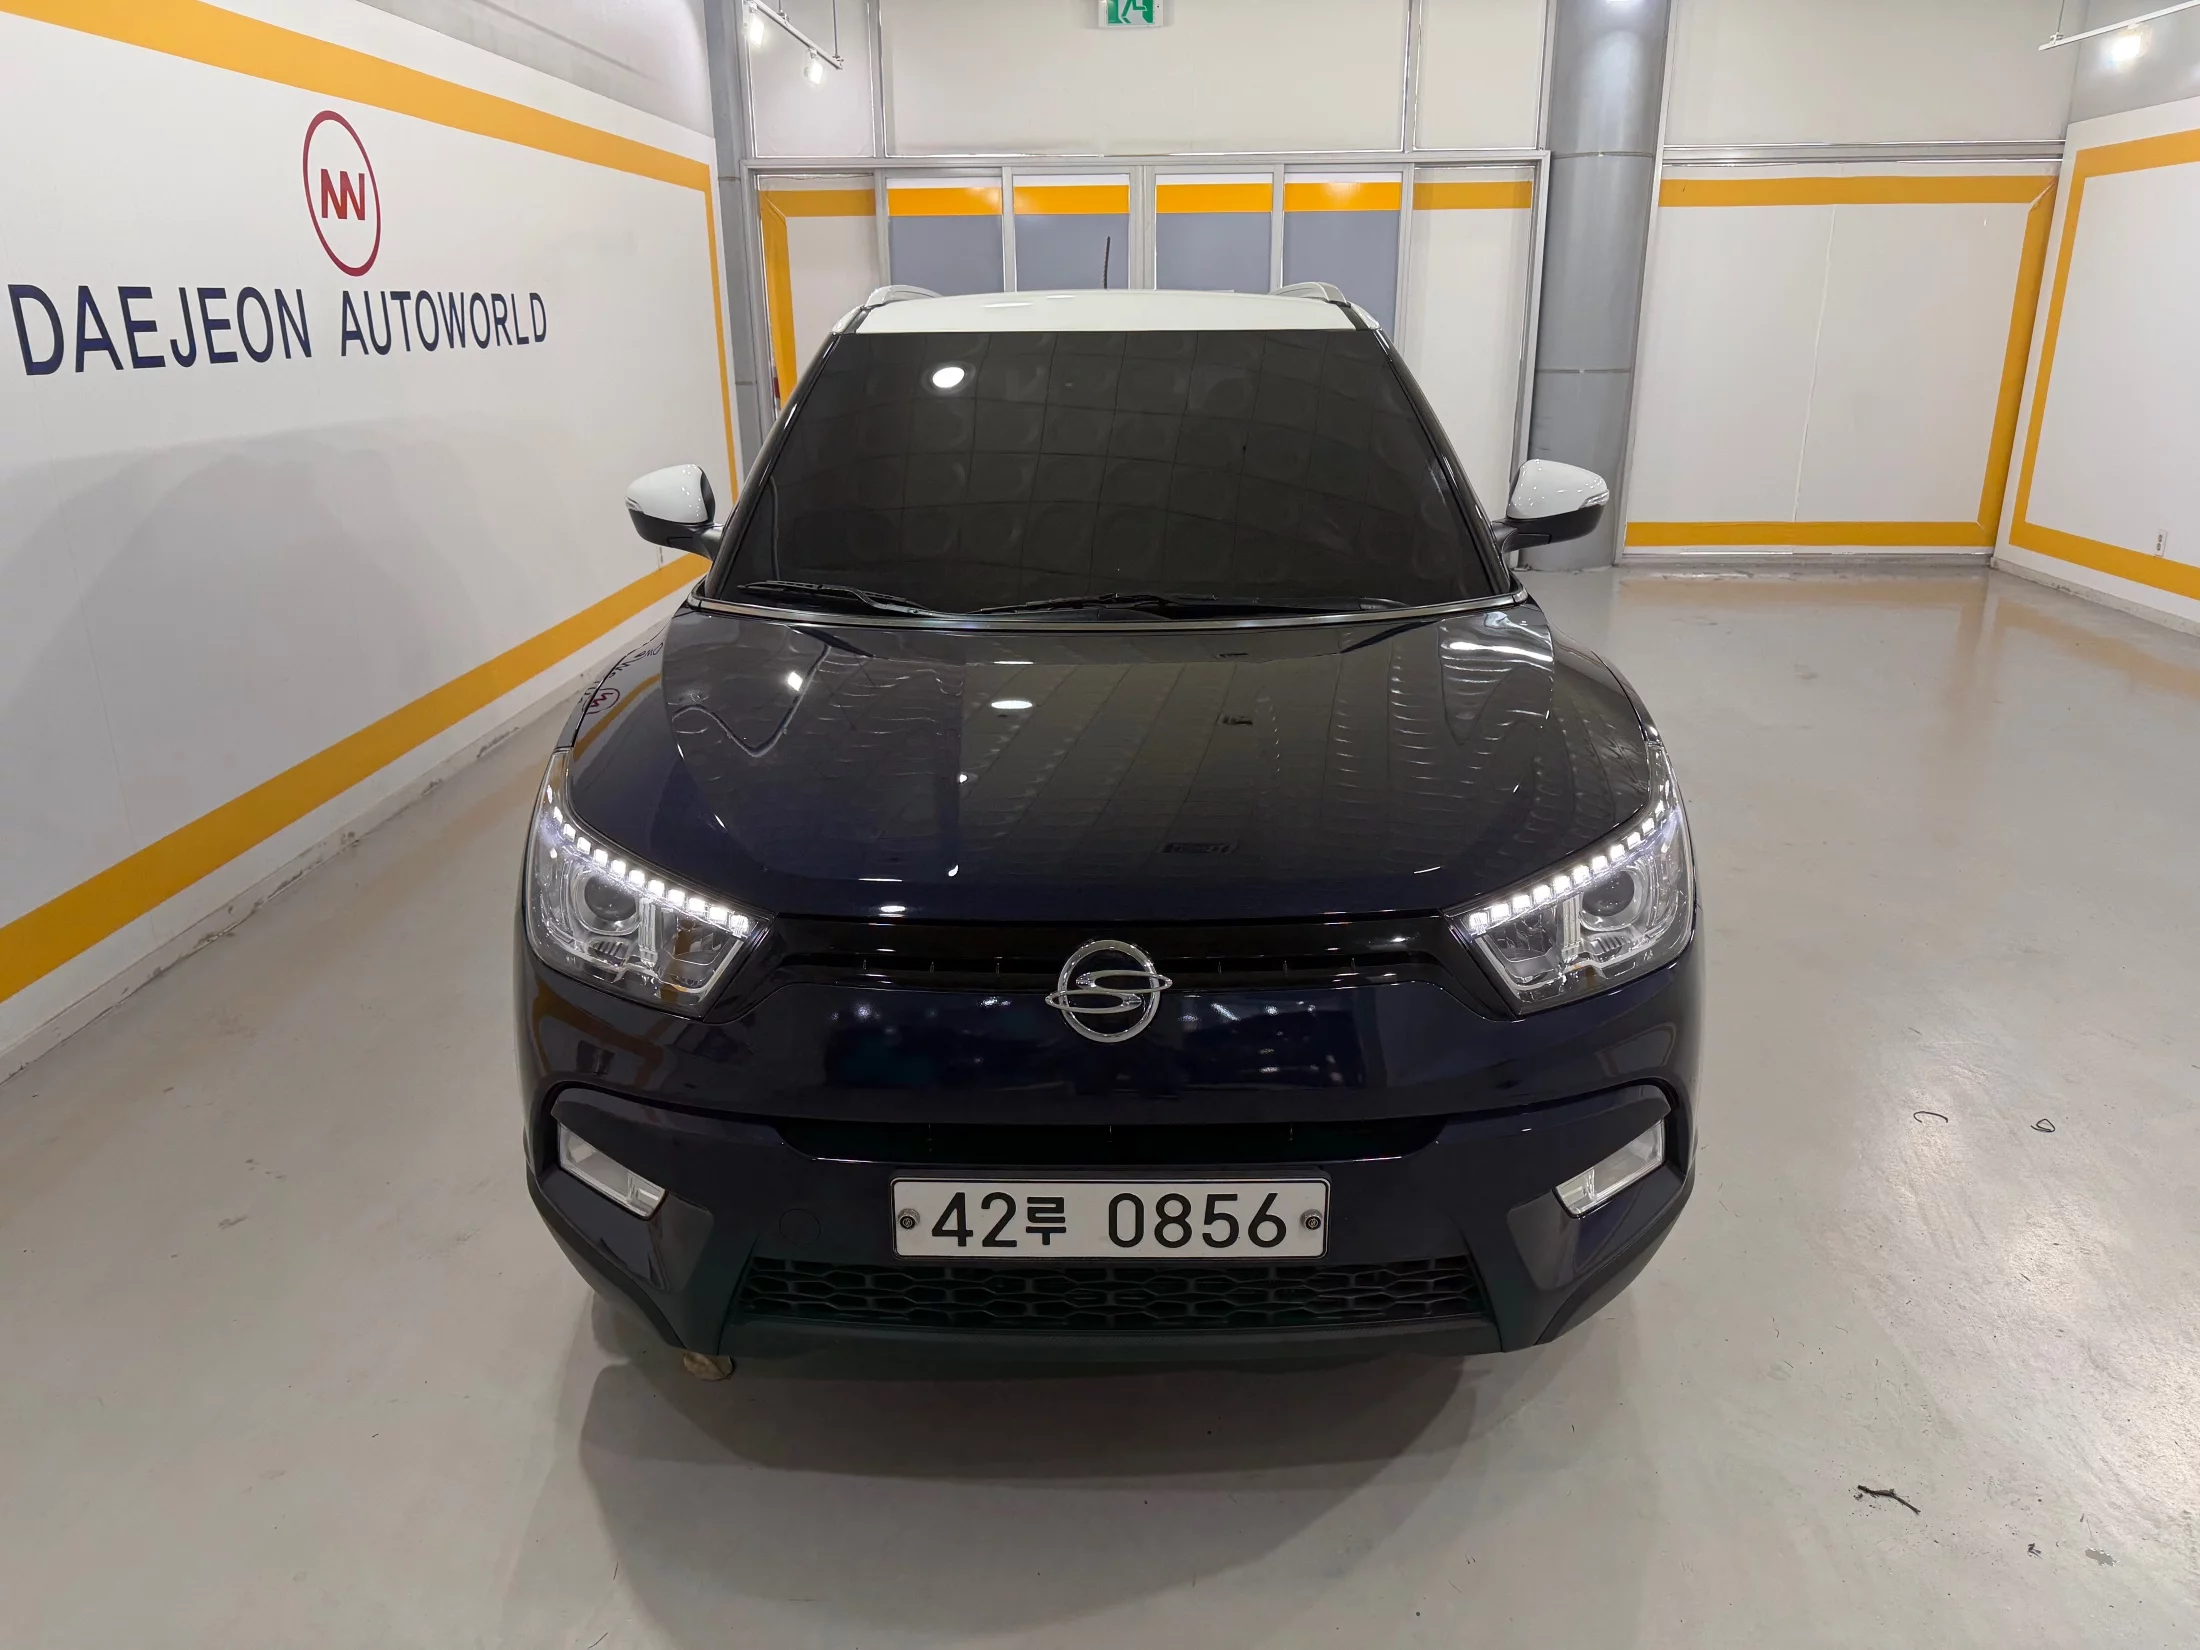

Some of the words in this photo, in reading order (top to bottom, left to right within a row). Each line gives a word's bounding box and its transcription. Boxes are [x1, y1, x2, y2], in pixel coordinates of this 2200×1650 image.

[8, 284, 312, 376] DAEJEON
[340, 290, 547, 357] AUTOWORLD
[931, 1191, 1067, 1248] 42루
[1108, 1192, 1287, 1249] 0856
